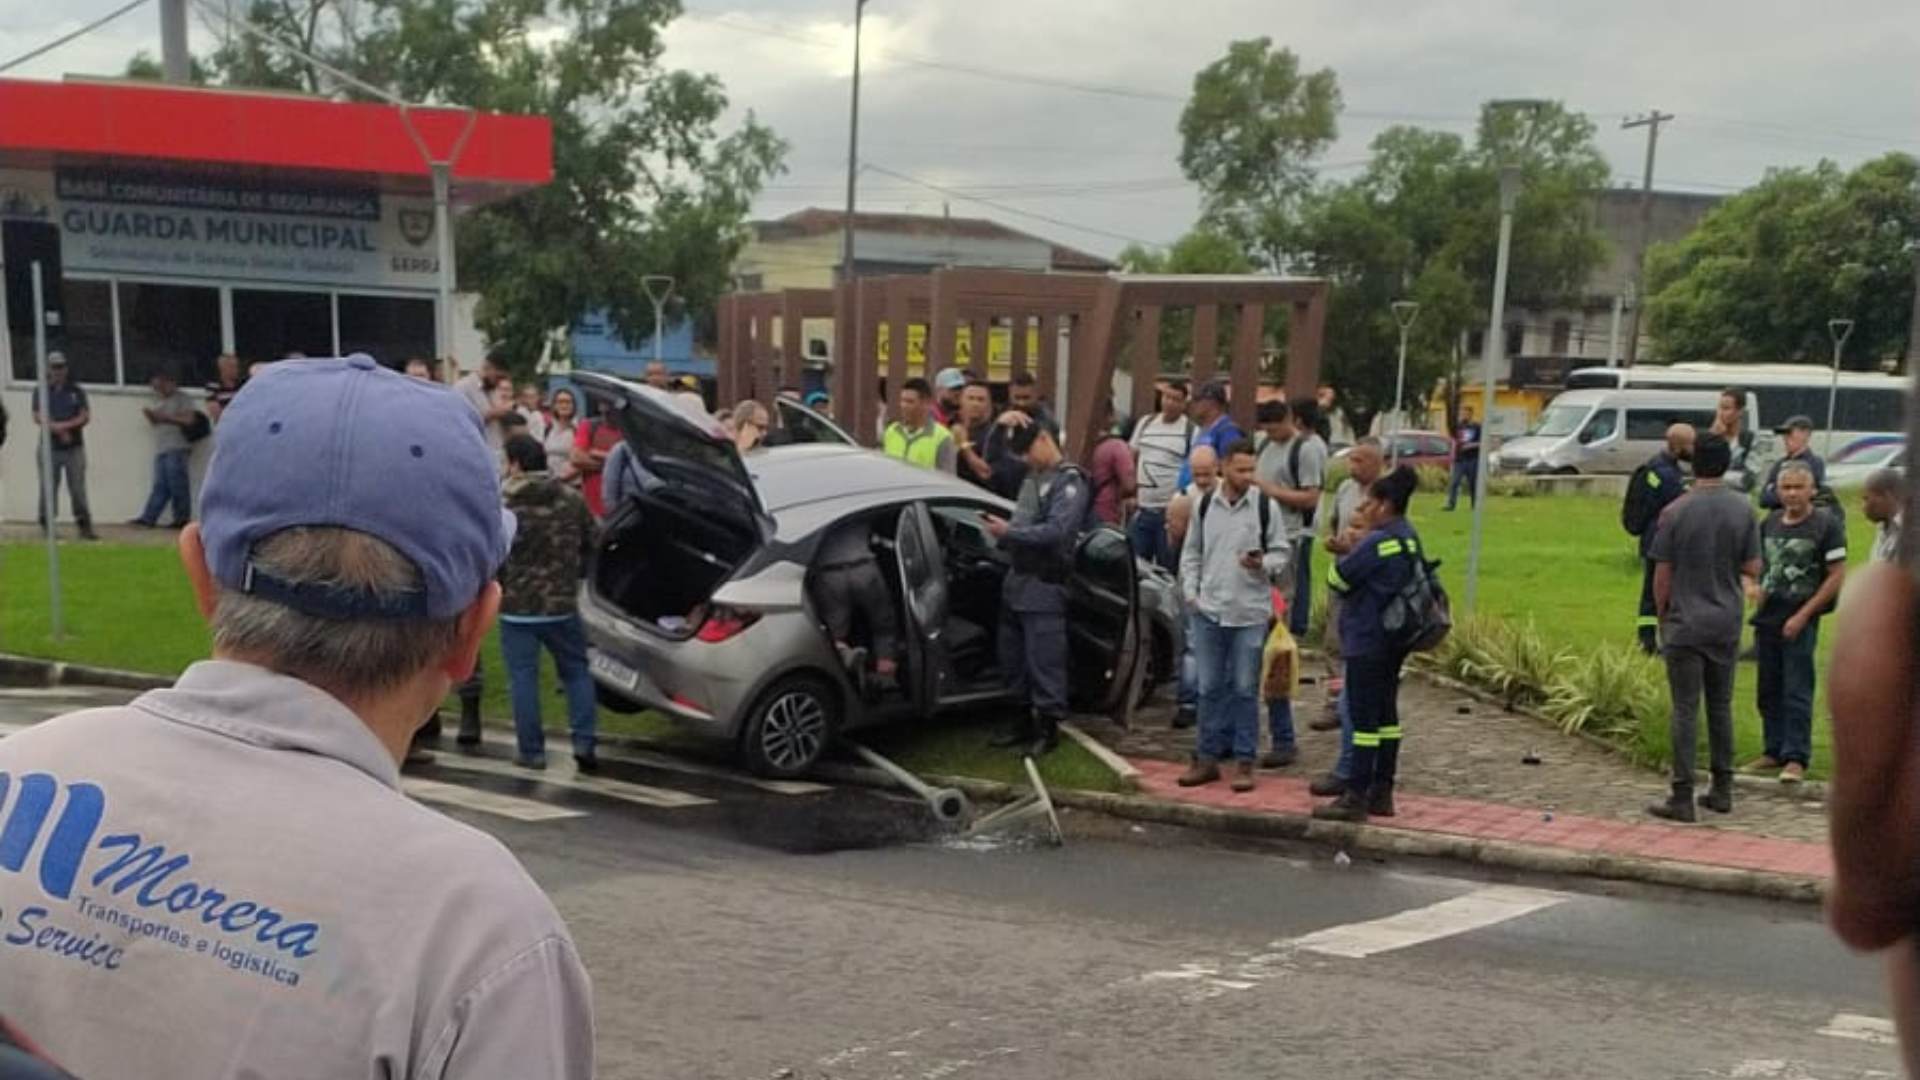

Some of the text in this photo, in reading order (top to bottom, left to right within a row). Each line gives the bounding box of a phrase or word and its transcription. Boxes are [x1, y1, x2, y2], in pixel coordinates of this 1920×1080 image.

[63, 207, 377, 252] GUARDA MUNICIPAL
[77, 896, 190, 948] Transportes
[195, 939, 209, 953] e
[92, 833, 320, 958] Morera
[5, 906, 125, 970] Service
